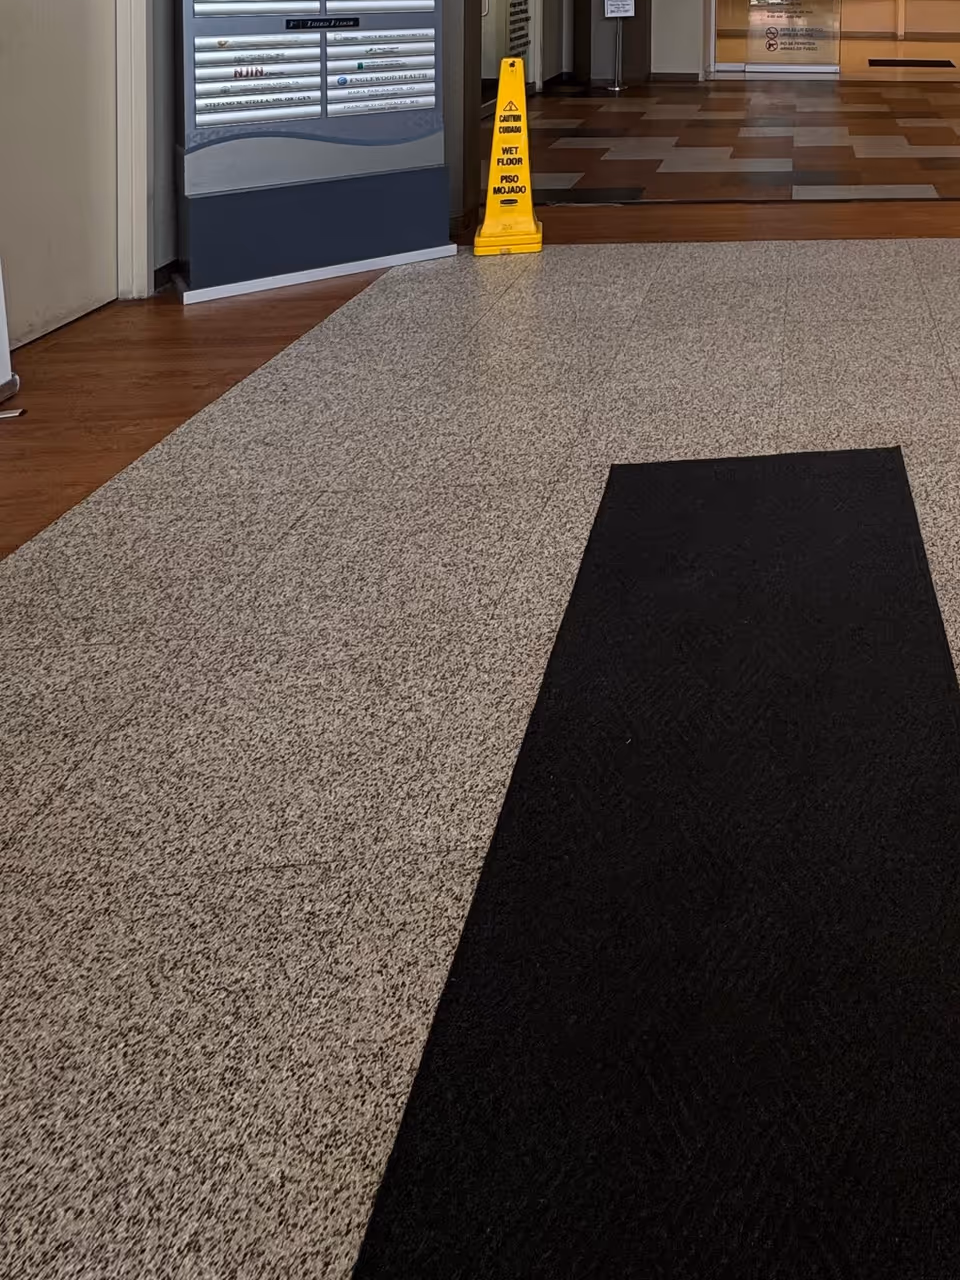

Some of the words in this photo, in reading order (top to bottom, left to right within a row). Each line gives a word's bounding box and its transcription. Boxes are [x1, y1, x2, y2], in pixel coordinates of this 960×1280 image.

[233, 67, 264, 78] NJIN
[499, 115, 521, 123] CAUTION
[499, 126, 521, 134] CUIDADO
[501, 146, 519, 155] WET
[497, 158, 523, 166] FLOOR
[500, 175, 519, 184] PISO
[493, 186, 526, 195] MOJADO
